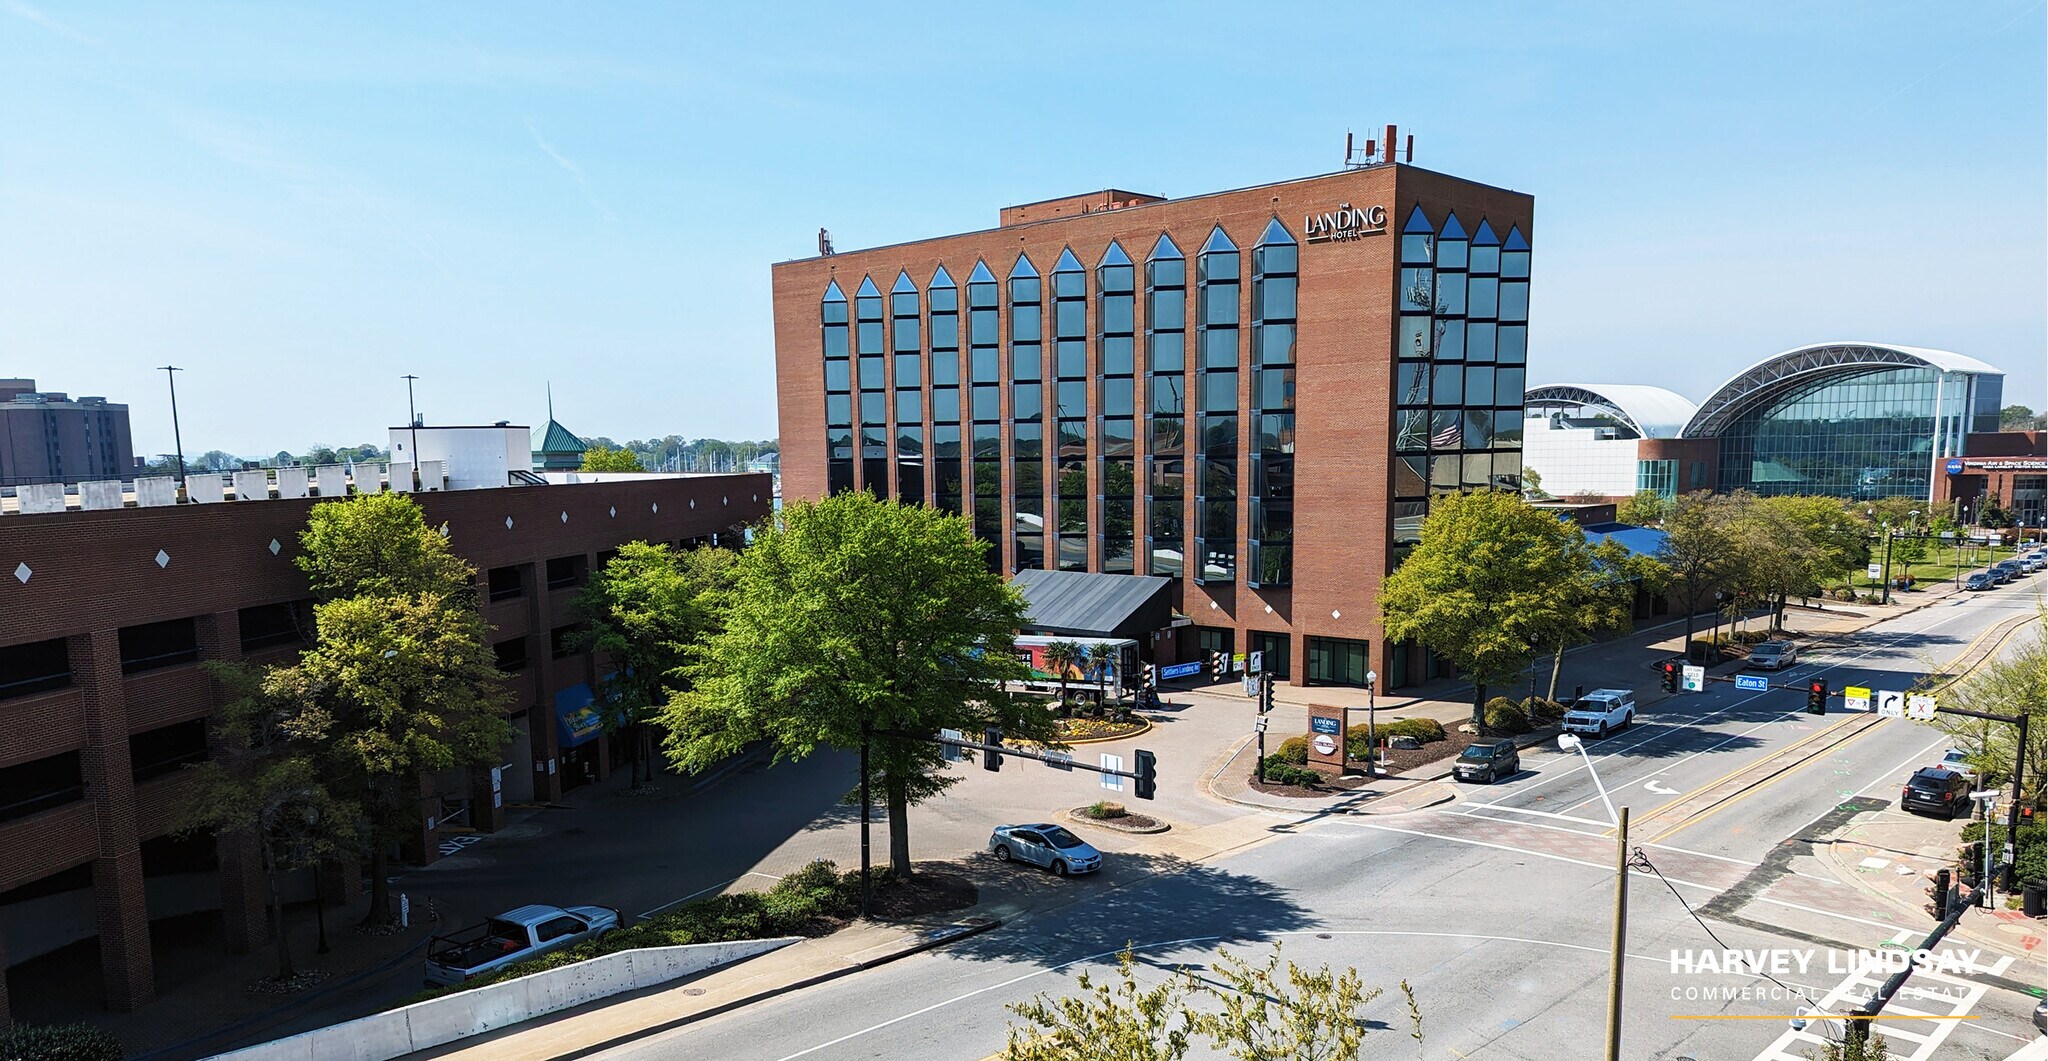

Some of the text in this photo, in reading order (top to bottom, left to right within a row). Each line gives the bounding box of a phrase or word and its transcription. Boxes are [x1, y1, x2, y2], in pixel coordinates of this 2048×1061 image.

[1305, 205, 1384, 233] LANDING
[1331, 230, 1357, 240] HOTEL
[1163, 667, 1178, 676] Settlers
[1179, 664, 1194, 673] Landing
[1737, 678, 1765, 688] Eaton St
